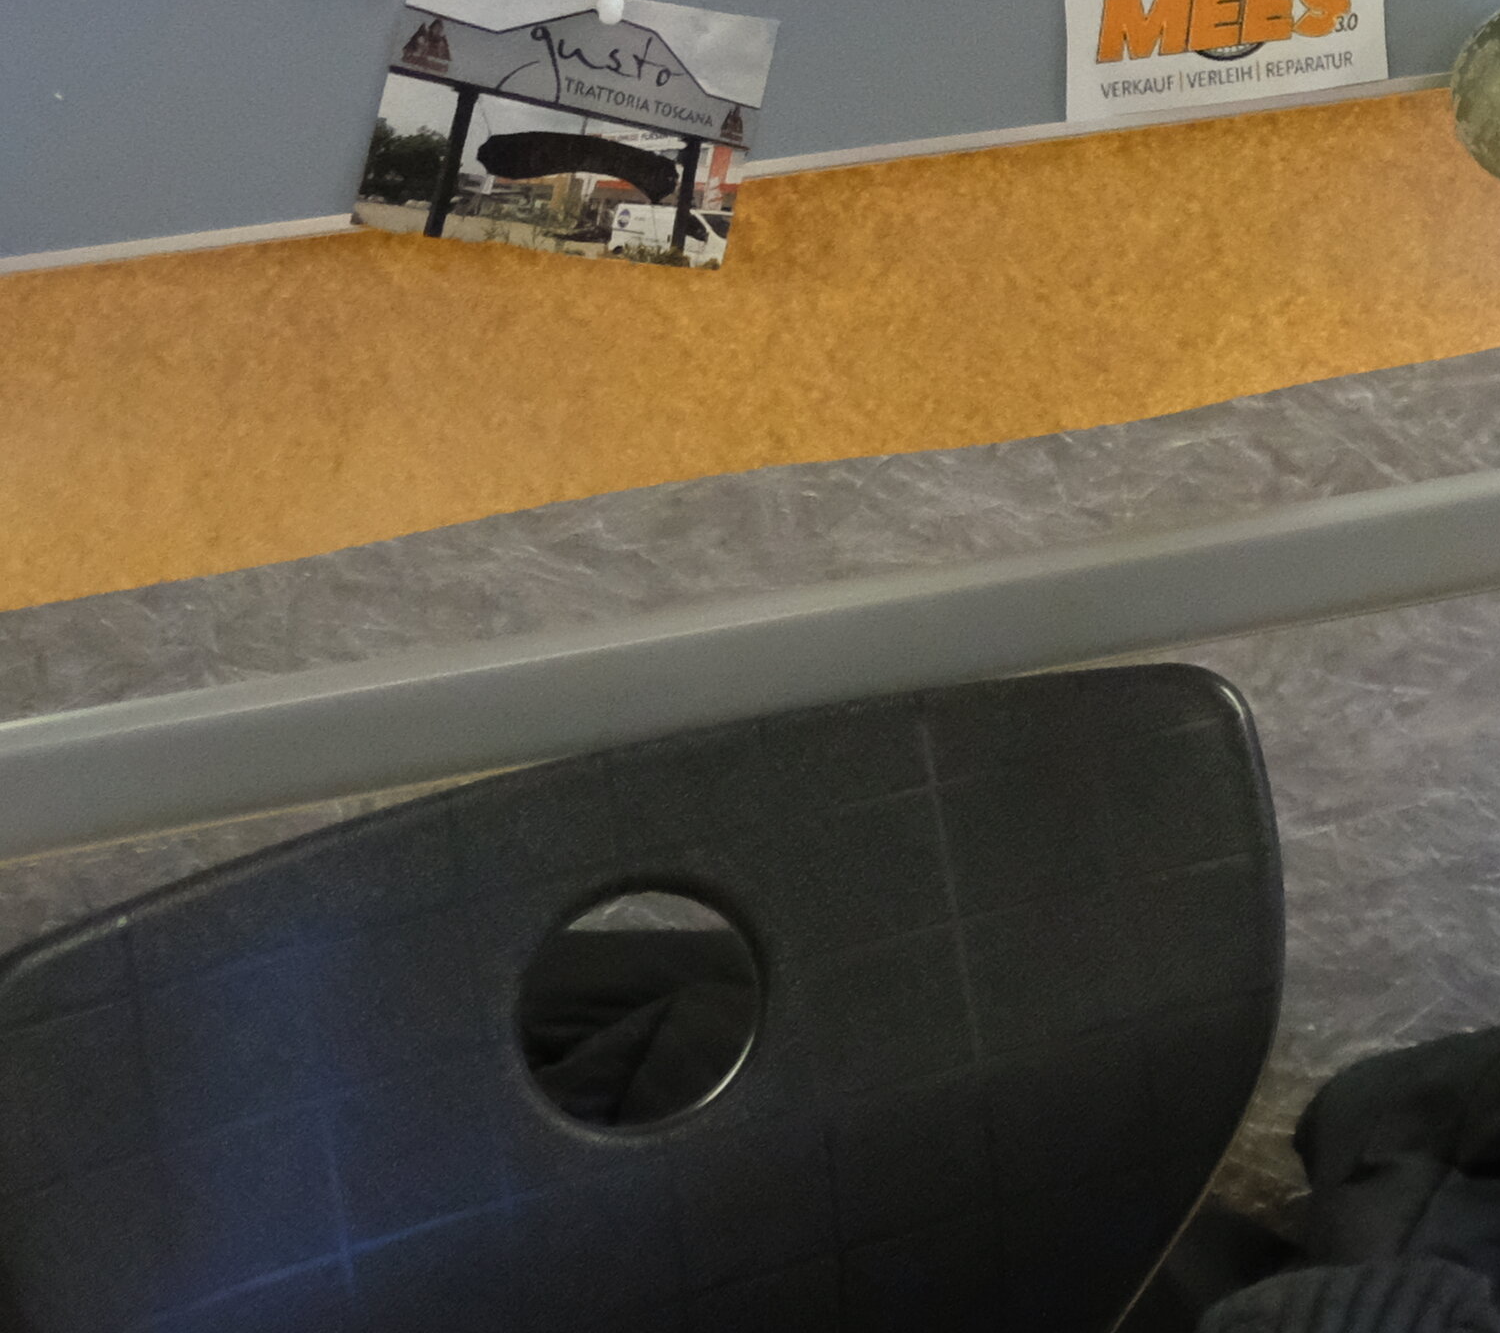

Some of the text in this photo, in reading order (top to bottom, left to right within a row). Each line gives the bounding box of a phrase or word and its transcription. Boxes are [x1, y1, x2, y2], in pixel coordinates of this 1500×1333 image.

[1334, 13, 1359, 33] 3.0
[1100, 51, 1354, 99] VERKAUF VERLEIH REPARATUR
[564, 75, 714, 128] TRATTORIA TOSCANA
